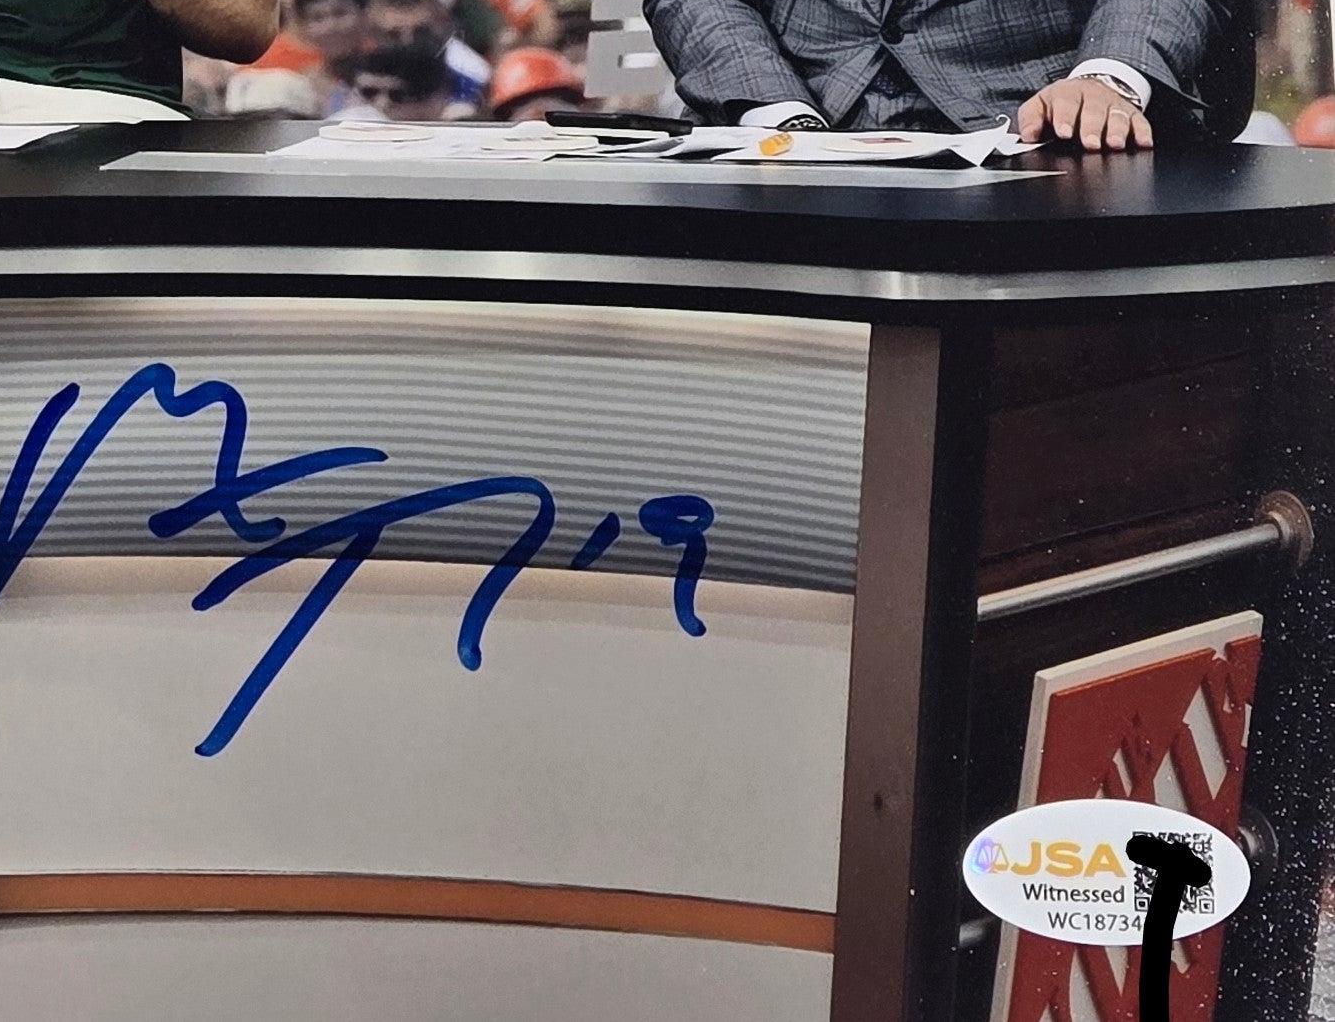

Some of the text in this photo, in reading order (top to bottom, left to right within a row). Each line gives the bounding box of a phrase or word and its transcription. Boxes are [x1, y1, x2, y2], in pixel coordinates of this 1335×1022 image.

[1010, 840, 1127, 878] JSA
[1022, 882, 1126, 903] Witnessed
[1047, 911, 1143, 932] WC18734
